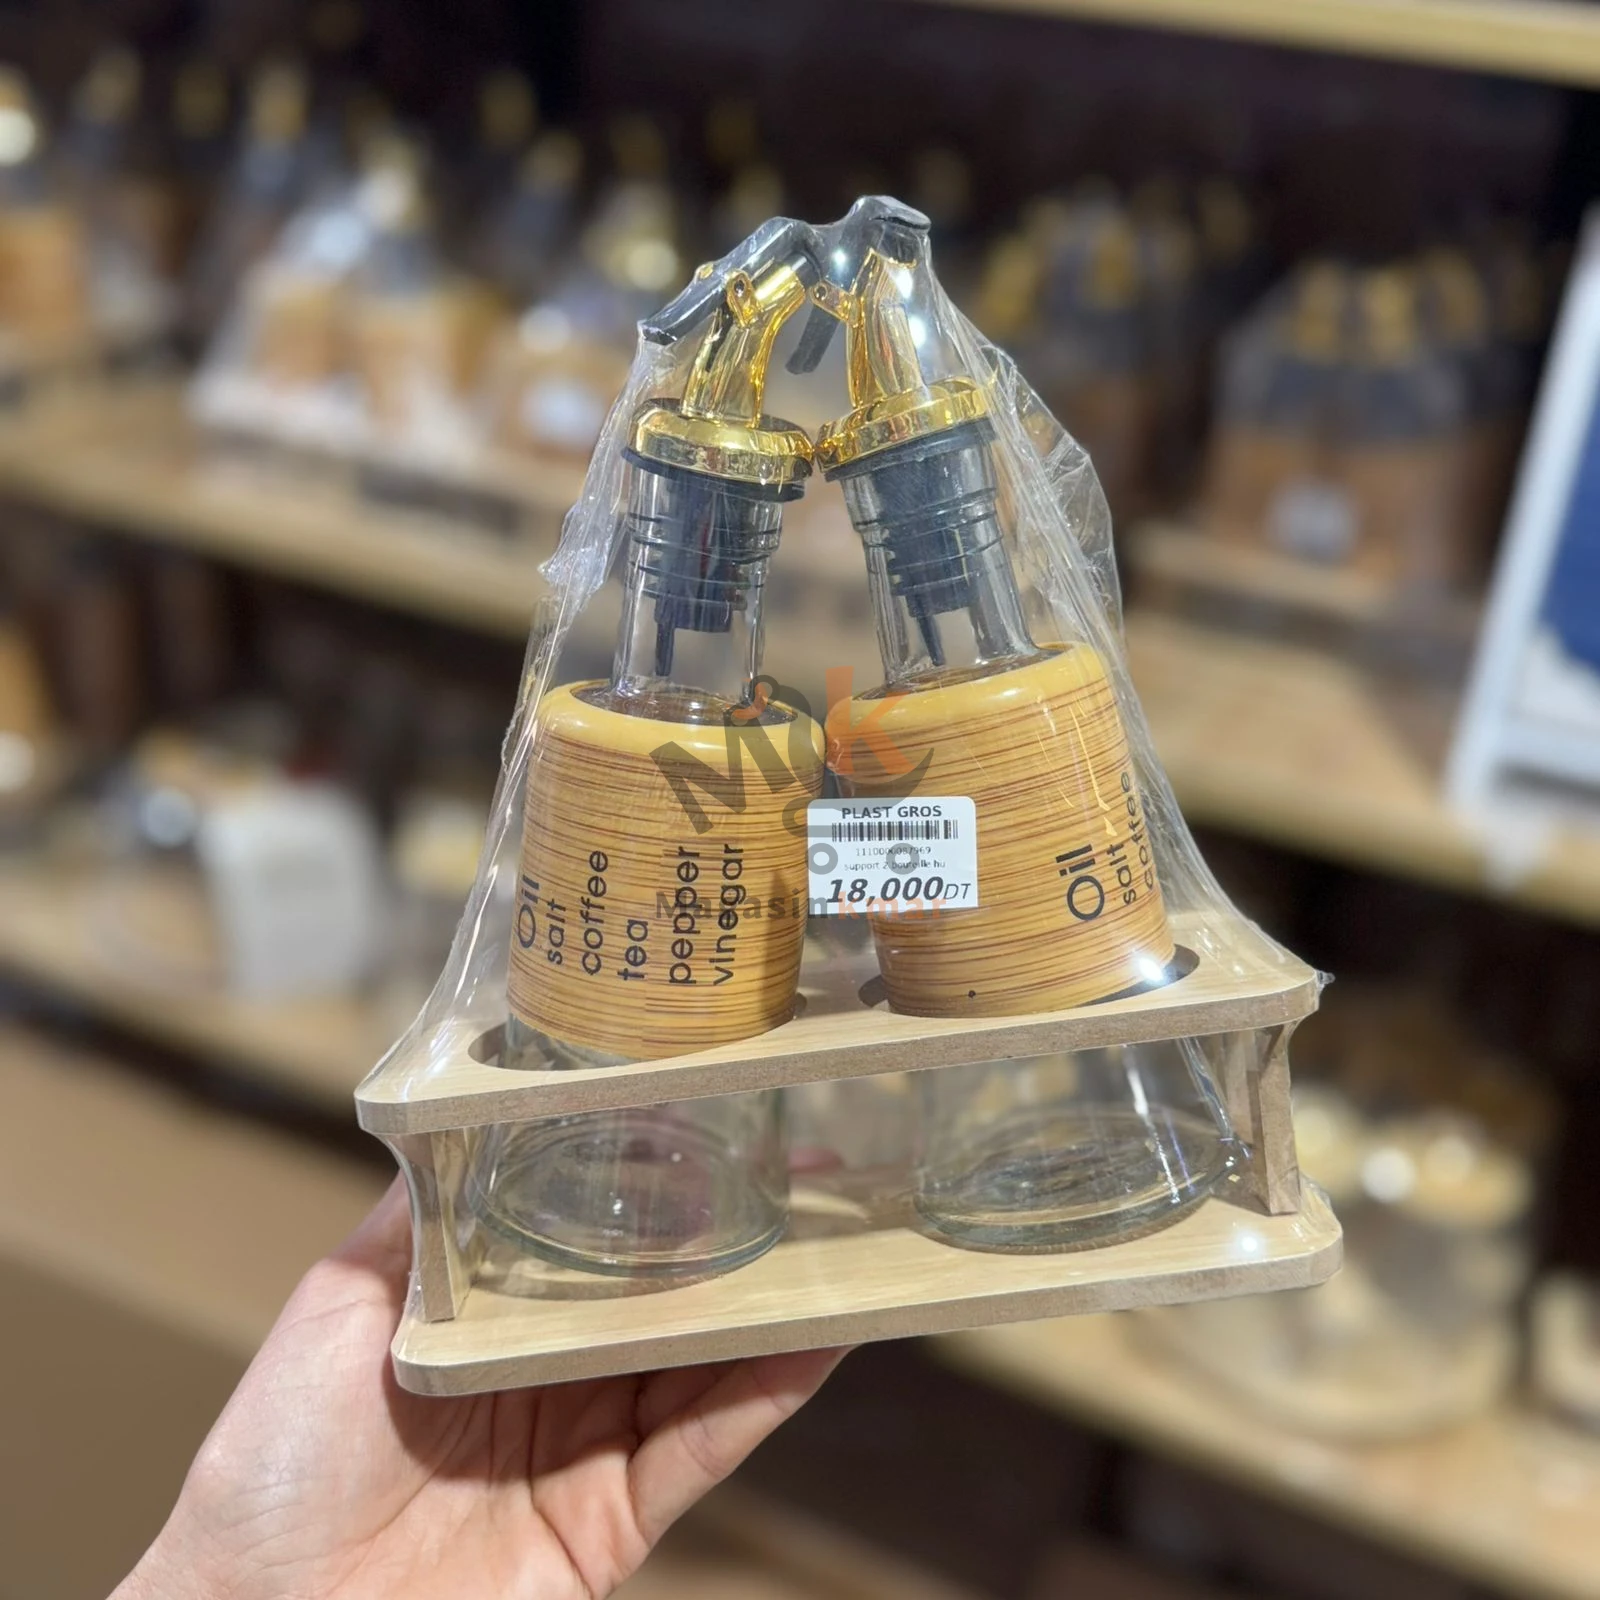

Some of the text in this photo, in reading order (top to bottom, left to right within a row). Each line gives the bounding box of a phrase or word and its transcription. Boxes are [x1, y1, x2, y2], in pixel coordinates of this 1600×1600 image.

[841, 804, 943, 820] PLAST GROS
[1120, 771, 1154, 889] coffee
[843, 861, 880, 872] support
[1055, 843, 1106, 922] Oil
[1106, 843, 1137, 906] salt
[516, 874, 540, 949] Oil
[545, 897, 567, 966] salt
[579, 849, 609, 977] coffee
[668, 845, 703, 985] pepper
[708, 843, 747, 986] vinegar
[616, 918, 649, 982] tea
